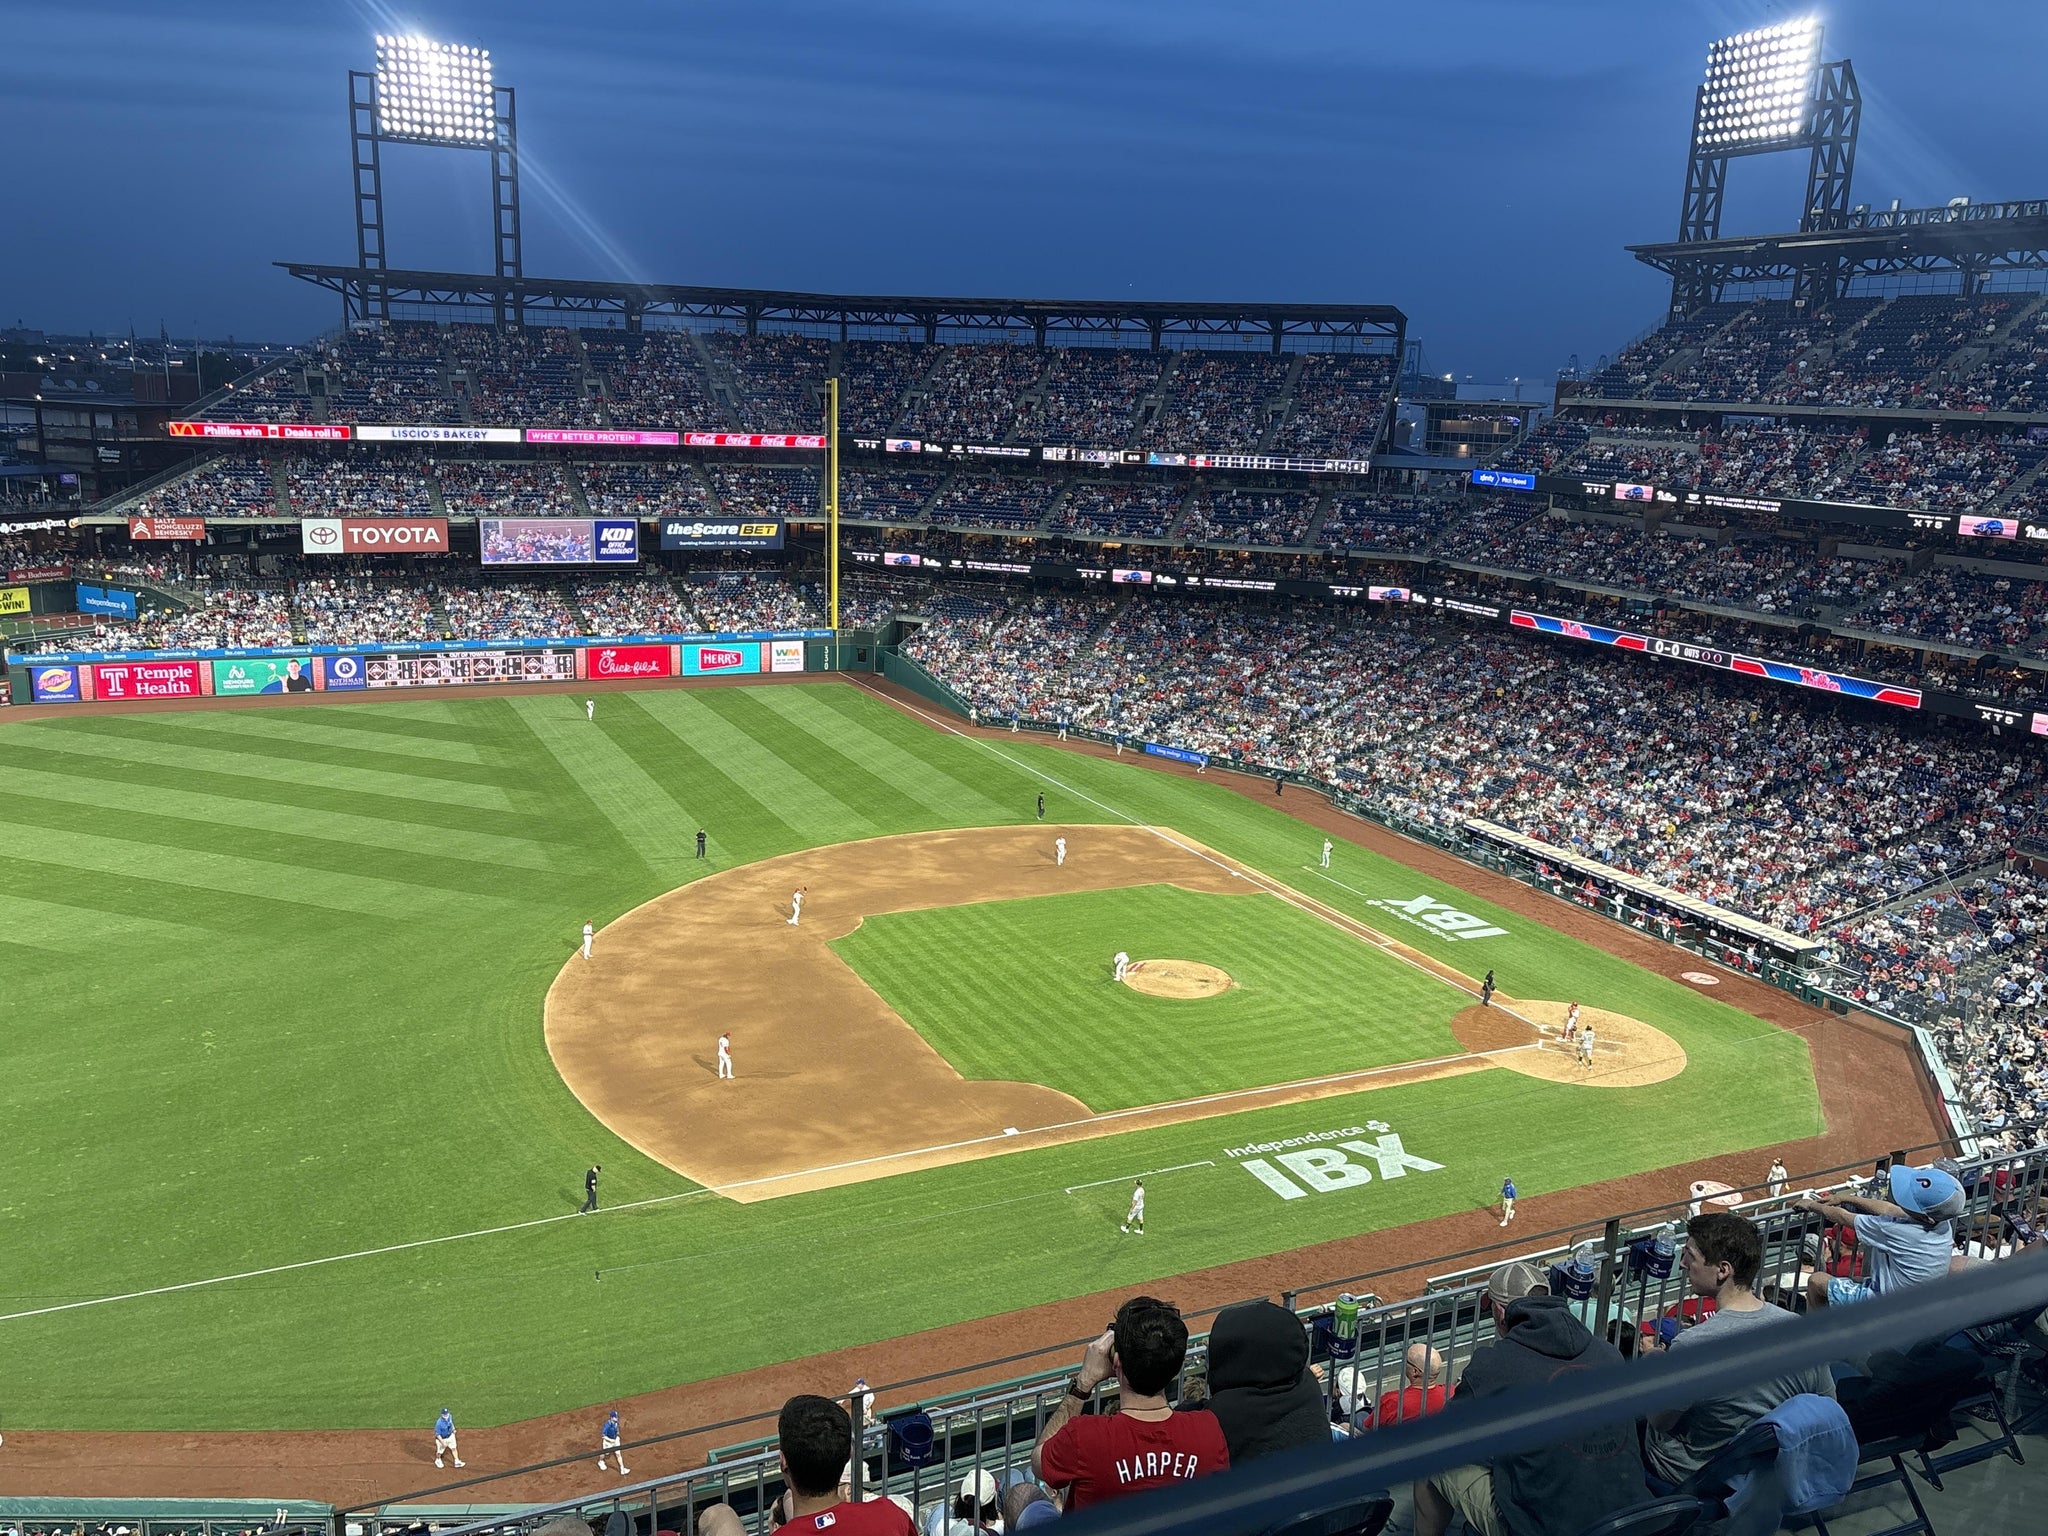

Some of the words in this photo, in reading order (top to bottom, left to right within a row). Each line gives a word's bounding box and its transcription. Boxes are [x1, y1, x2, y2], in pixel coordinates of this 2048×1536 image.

[204, 426, 242, 436] Phillies
[244, 427, 262, 436] win
[285, 427, 313, 438] Deals
[314, 428, 331, 438] roll
[332, 428, 342, 438] in
[392, 430, 440, 438] LISCIO'S
[444, 430, 488, 440] BAKERY
[532, 432, 560, 440] WHEY
[562, 432, 594, 441] BETTER
[598, 433, 635, 442] PROTEIN
[690, 434, 716, 446] Coca-Cola
[725, 434, 752, 446] Coca-Cola
[761, 435, 786, 446] Coca-Cola
[795, 436, 820, 447] Coca-Cola
[349, 527, 441, 544] TOYOTA
[743, 526, 774, 534] BET
[28, 570, 64, 579] Budweiser
[0, 592, 13, 601] AY
[4, 601, 24, 610] WIN!
[86, 597, 120, 609] Independence
[1561, 621, 1590, 640] Phillies
[776, 649, 799, 657] WM
[1655, 640, 1679, 656] 0-0
[1684, 647, 1700, 659] OUTS
[703, 652, 738, 665] HERR'S
[598, 656, 660, 675] Chick-fil-A
[134, 667, 192, 682] Temple
[1800, 669, 1840, 692] Phillies
[136, 680, 191, 695] Health
[1382, 894, 1511, 939] IBX
[1380, 905, 1458, 942] Independence
[1222, 1125, 1366, 1158] Independence
[1240, 1133, 1447, 1200] IBX
[1116, 1451, 1198, 1484] HARPER
